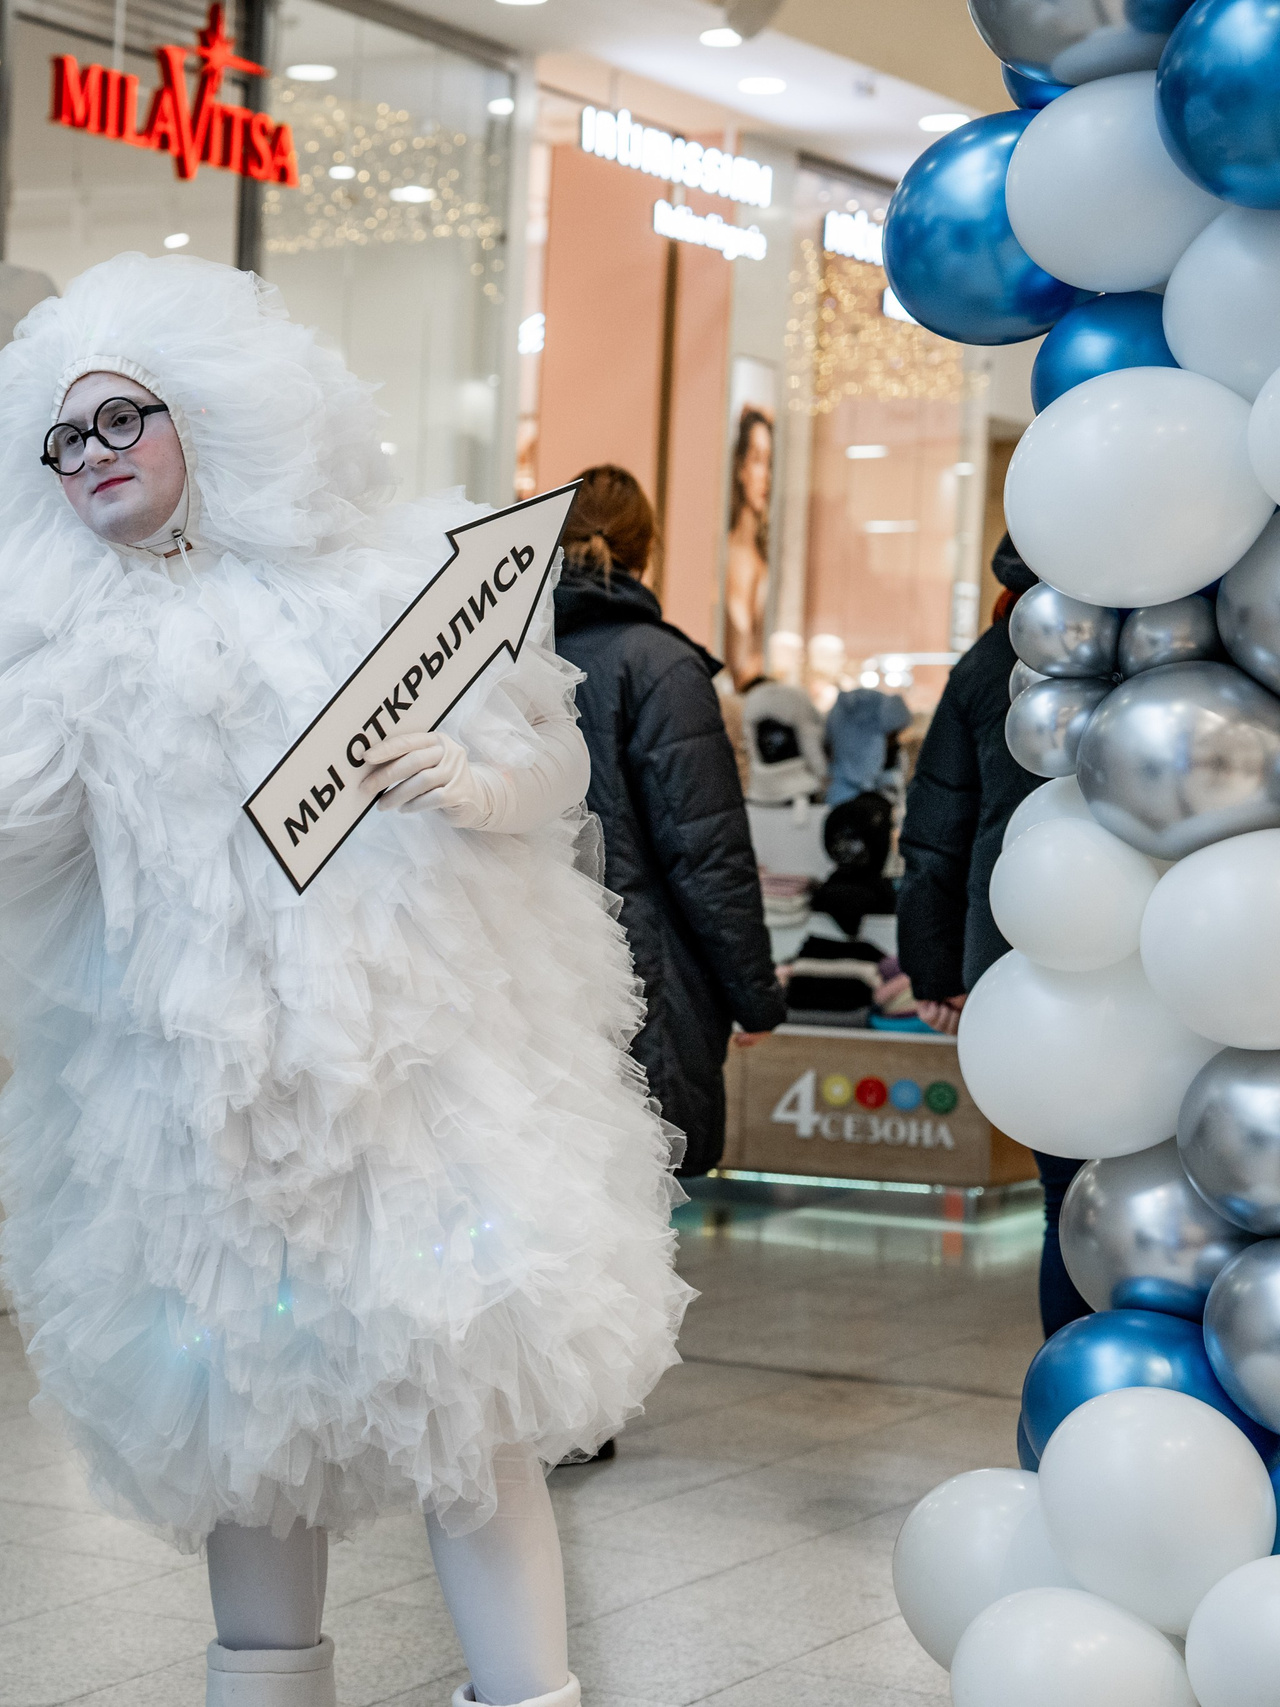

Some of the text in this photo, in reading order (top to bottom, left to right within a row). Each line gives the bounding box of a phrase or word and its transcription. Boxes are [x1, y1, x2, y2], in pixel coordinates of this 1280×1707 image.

[283, 544, 535, 847] МЫ ОТКРЫЛИСЬ
[772, 1069, 955, 1149] 4 СЕЗОНА
